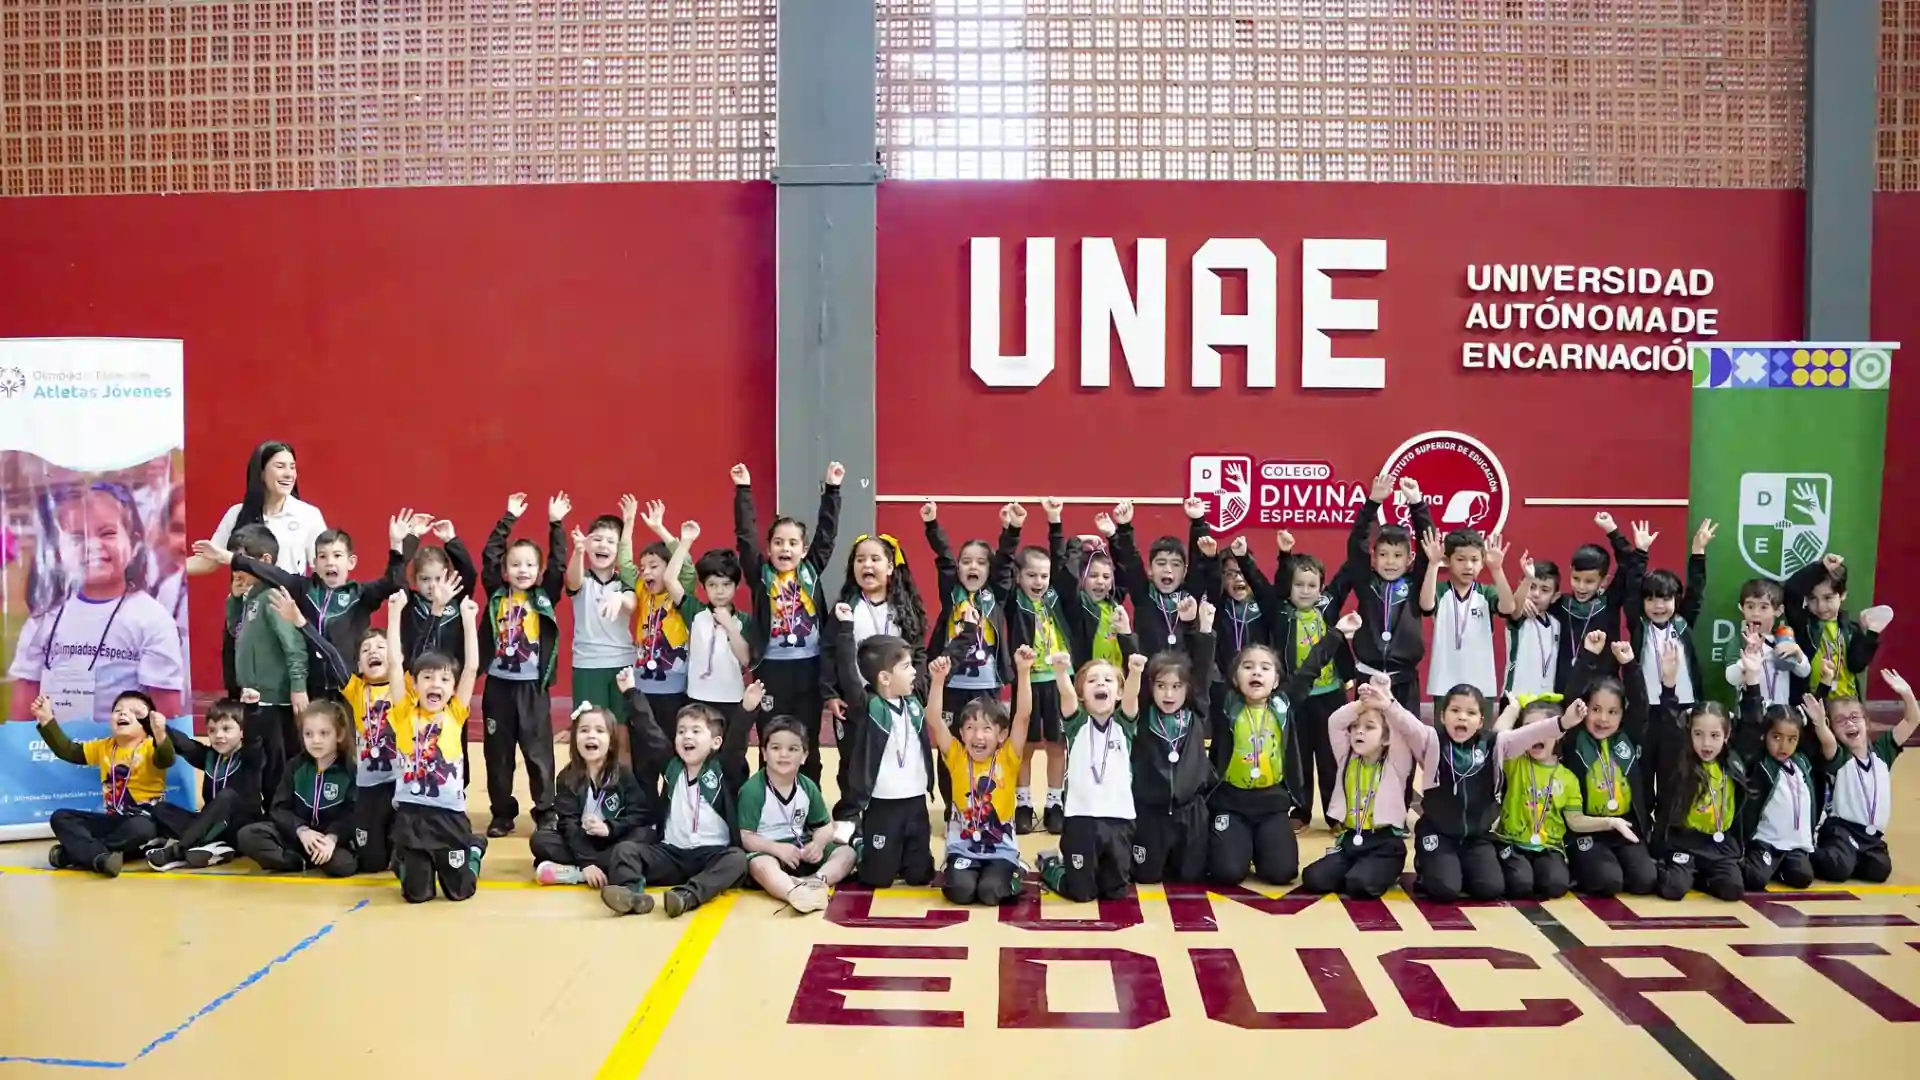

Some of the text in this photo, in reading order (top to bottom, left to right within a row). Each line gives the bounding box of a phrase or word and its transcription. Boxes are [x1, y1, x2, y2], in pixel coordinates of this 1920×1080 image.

[1466, 264, 1715, 296] UNIVERSIDAD
[970, 237, 1387, 389] UNAE
[1465, 296, 1719, 335] AUTÓNOMA DE
[33, 384, 172, 399] Atletas Jóvenes
[1263, 466, 1329, 477] COLEGIO
[1415, 441, 1457, 456] SUPERIOR
[1457, 444, 1469, 455] DE
[1468, 450, 1499, 493] EDUCACIÓN
[1260, 484, 1367, 507] DIVINA
[1757, 491, 1772, 506] D
[1260, 509, 1356, 523] ESPERANZ
[1755, 537, 1769, 553] E
[787, 941, 1920, 1029] EDUCAT
